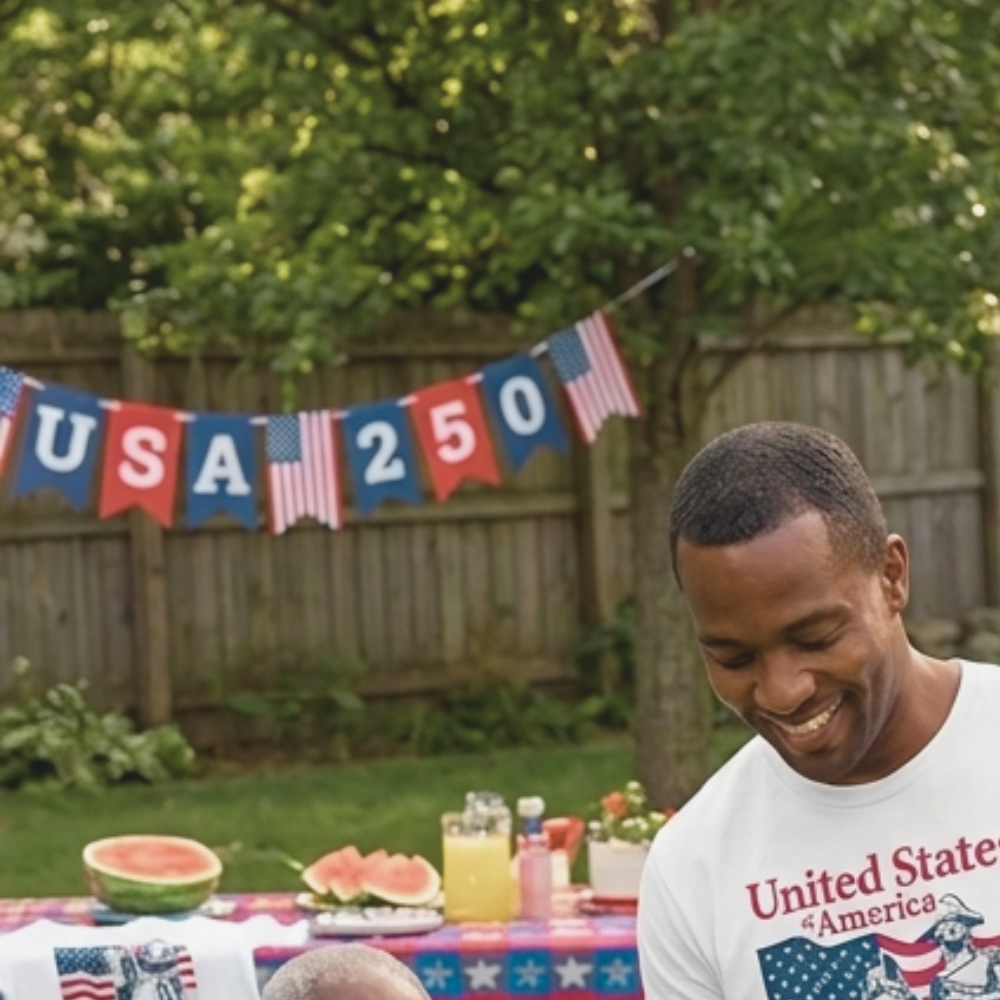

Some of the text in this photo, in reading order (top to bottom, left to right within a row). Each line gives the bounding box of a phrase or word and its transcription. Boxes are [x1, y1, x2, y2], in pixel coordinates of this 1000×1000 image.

[34, 375, 547, 495] USA 250
[746, 853, 885, 921] United
